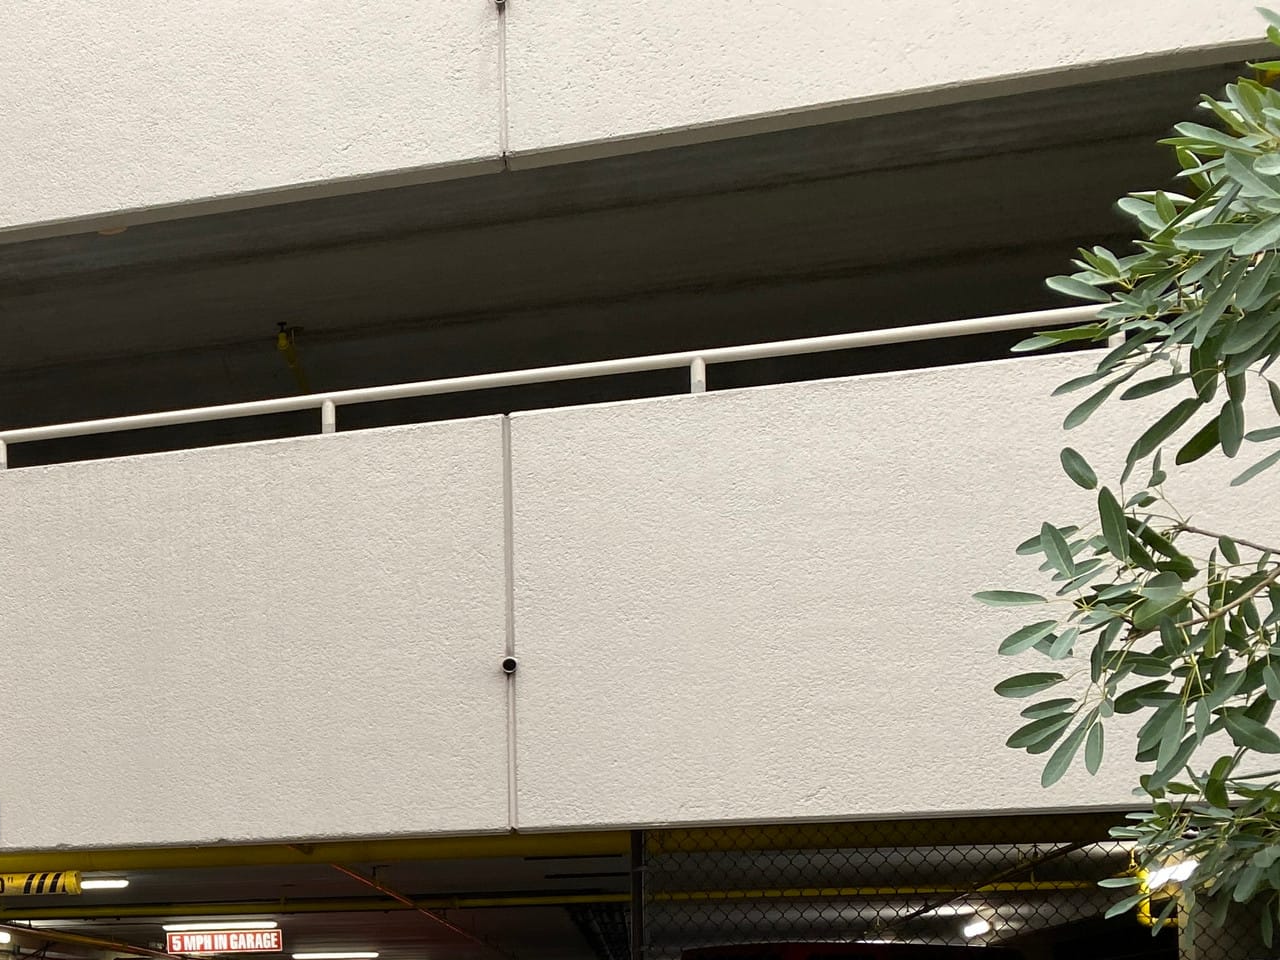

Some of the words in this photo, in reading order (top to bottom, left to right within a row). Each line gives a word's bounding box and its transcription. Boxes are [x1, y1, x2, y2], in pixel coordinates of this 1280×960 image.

[172, 935, 182, 951] 5
[183, 934, 212, 951] MPH
[214, 934, 227, 950] IN
[229, 932, 278, 949] GARAGE
